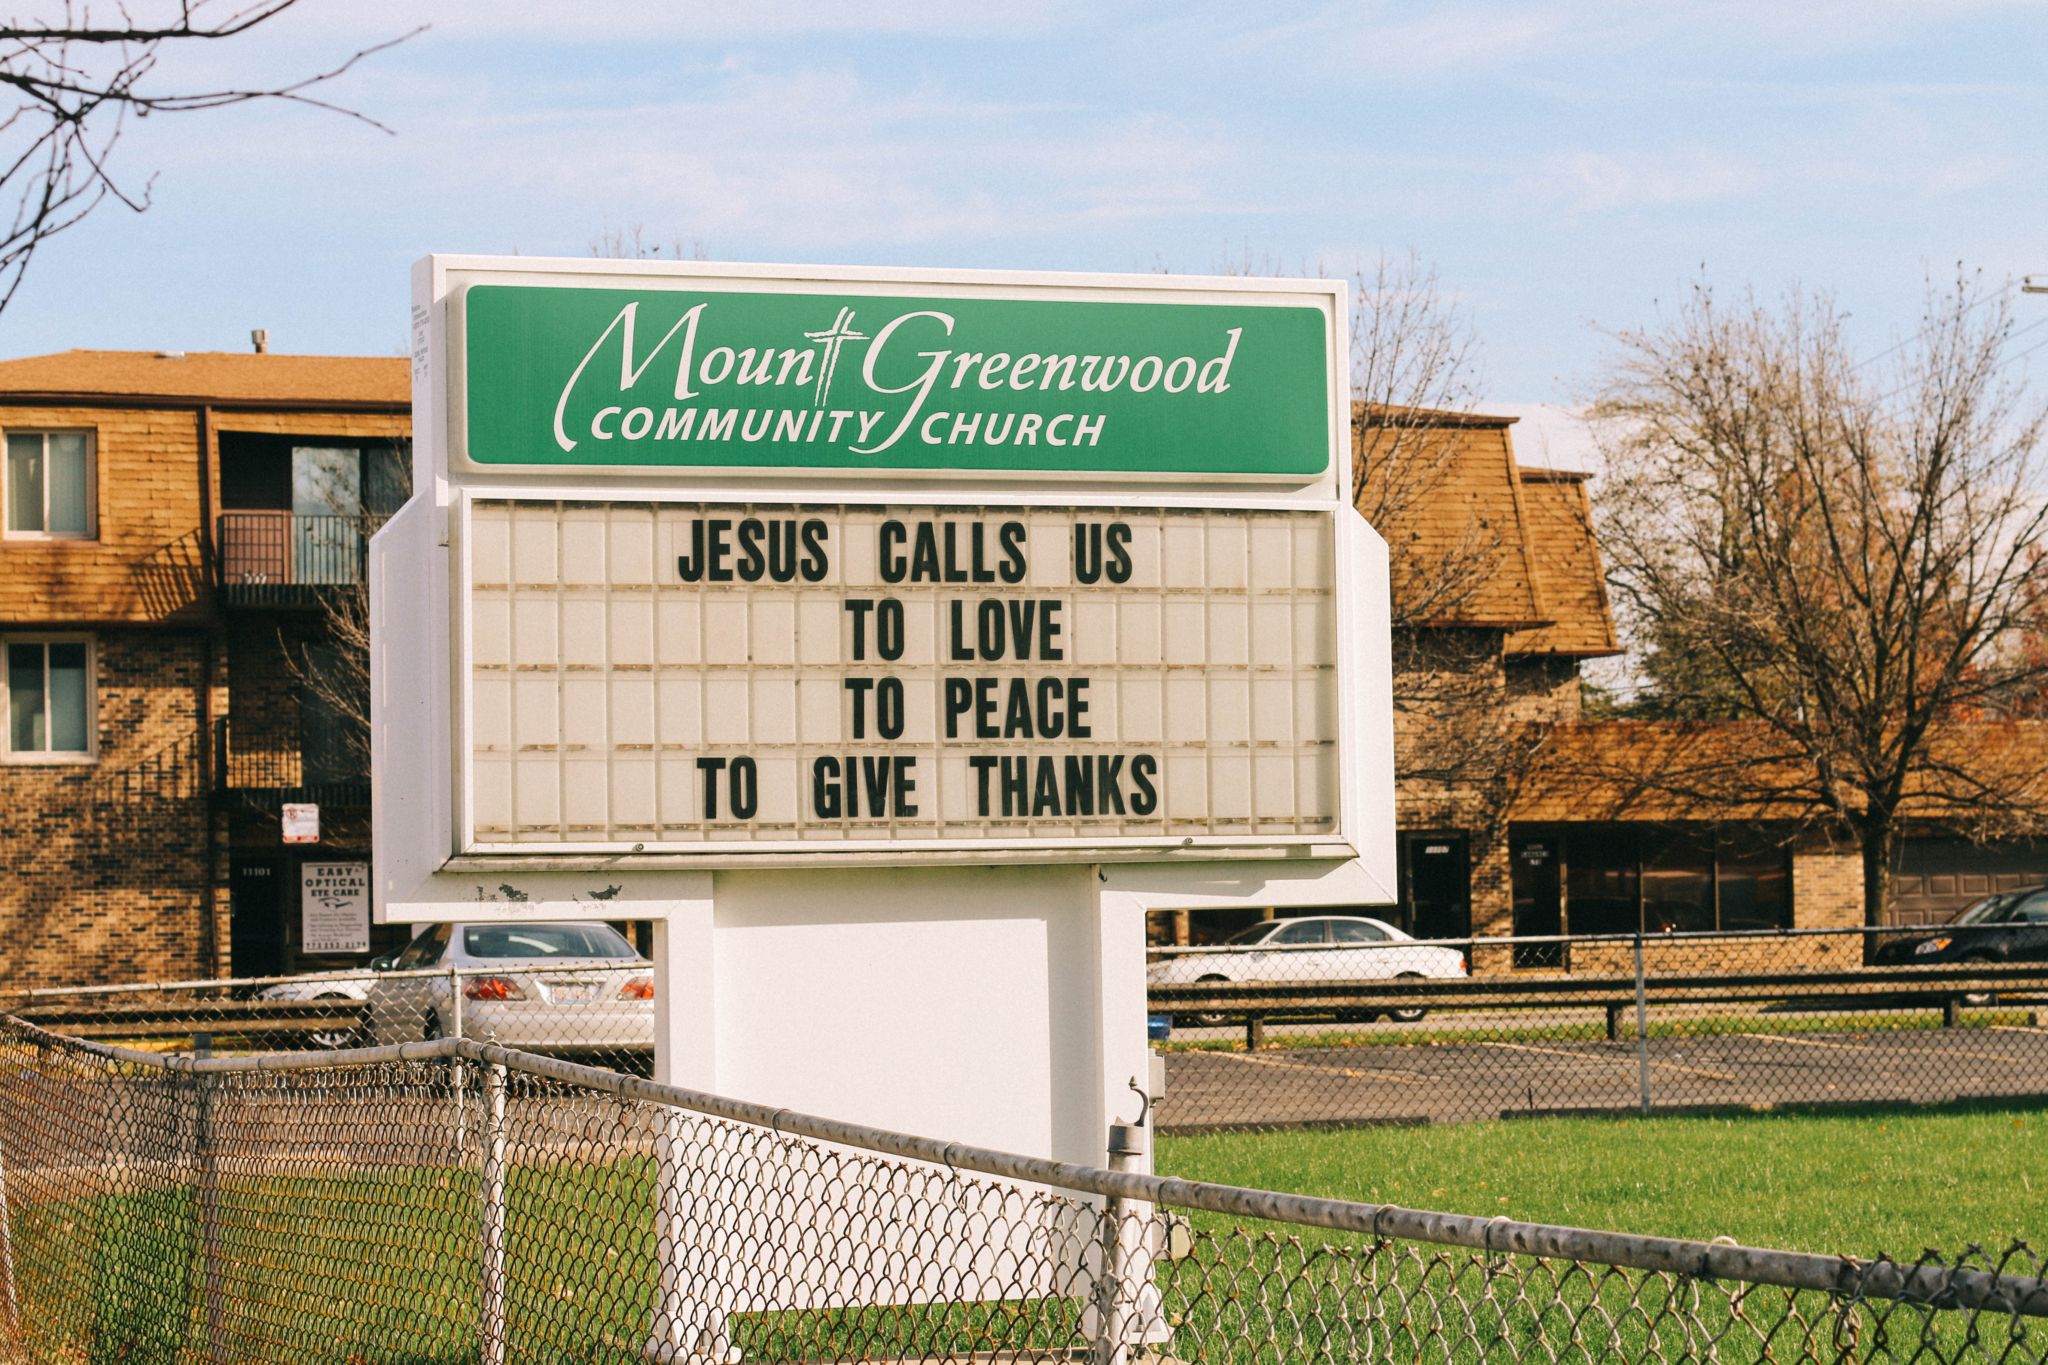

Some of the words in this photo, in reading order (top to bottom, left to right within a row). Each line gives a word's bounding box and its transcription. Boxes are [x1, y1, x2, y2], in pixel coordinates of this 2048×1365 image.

[554, 301, 870, 452] Mount
[849, 311, 1243, 454] Greenwood
[591, 406, 885, 443] COMMUNITY
[920, 411, 1106, 446] CHURCH
[678, 518, 829, 583] JESUS
[879, 519, 1027, 584] CALLS
[1075, 521, 1133, 585] US
[845, 597, 905, 661] TO
[951, 598, 1063, 661] LOVE
[845, 675, 905, 740] TO
[945, 675, 1091, 740] PEACE
[697, 755, 758, 819] TO
[813, 754, 919, 819] GIVE
[969, 753, 1157, 818] THANKS
[305, 879, 366, 887] OPTICAL
[311, 889, 329, 897] EYE
[333, 889, 360, 897] CARE
[317, 868, 353, 877] EASY
